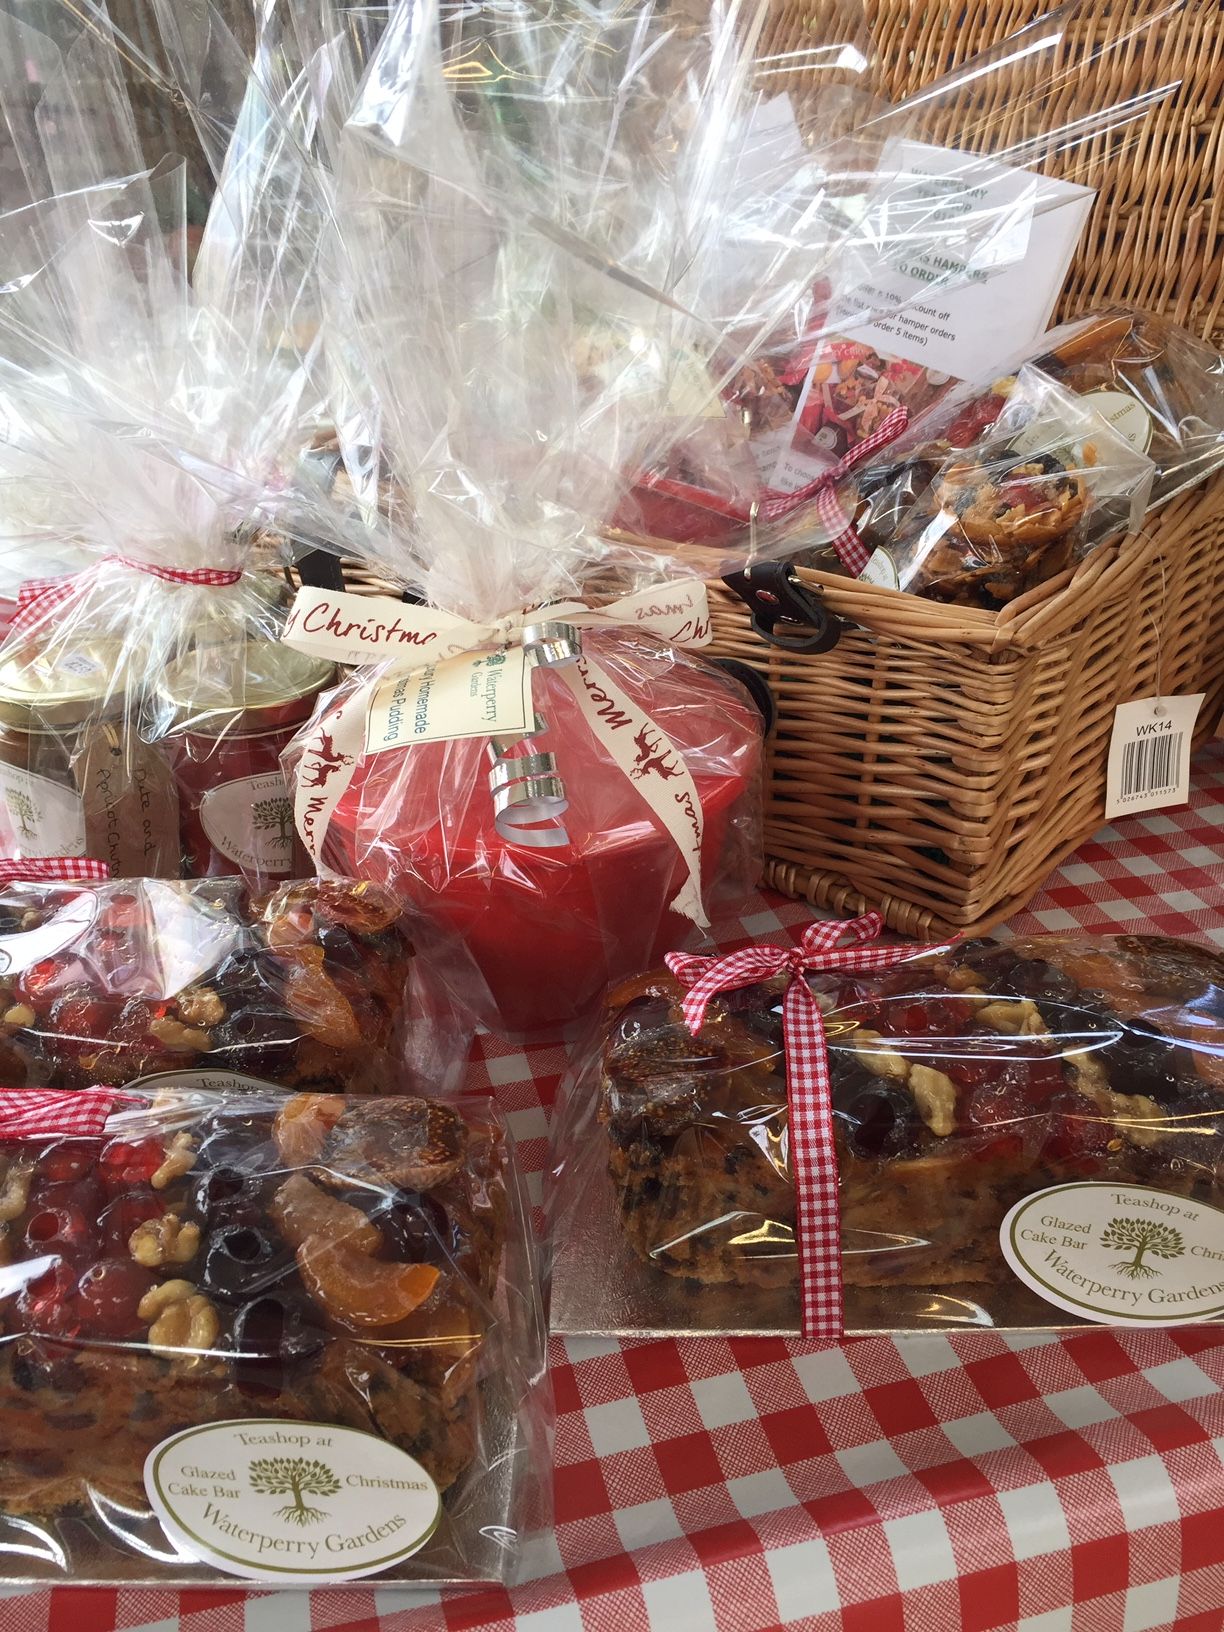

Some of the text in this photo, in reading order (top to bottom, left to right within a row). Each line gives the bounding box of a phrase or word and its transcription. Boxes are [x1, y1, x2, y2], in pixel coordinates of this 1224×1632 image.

[911, 266, 950, 286] ORDR
[933, 254, 989, 283] HAMPRS
[899, 314, 929, 332] hamper
[930, 327, 956, 341] orders
[938, 311, 951, 321] off
[873, 321, 928, 346] order 5 items)
[303, 602, 438, 645] Christm
[414, 679, 435, 734] Homemade
[481, 668, 503, 723] Waterperry
[383, 698, 407, 741] Pudding
[1136, 720, 1173, 736] WK14
[303, 796, 329, 857] Merr
[1110, 1193, 1200, 1222] Teashop at
[1040, 1215, 1092, 1234] Glazed
[1020, 1229, 1088, 1250] Cake Bar
[1044, 1248, 1143, 1307] Waterperry
[233, 1431, 333, 1448] Teashop at
[180, 1465, 236, 1481] Glazed
[345, 1474, 429, 1491] Christmas
[168, 1481, 240, 1499] Cake Bar
[201, 1502, 407, 1560] Waterperry Gardens
